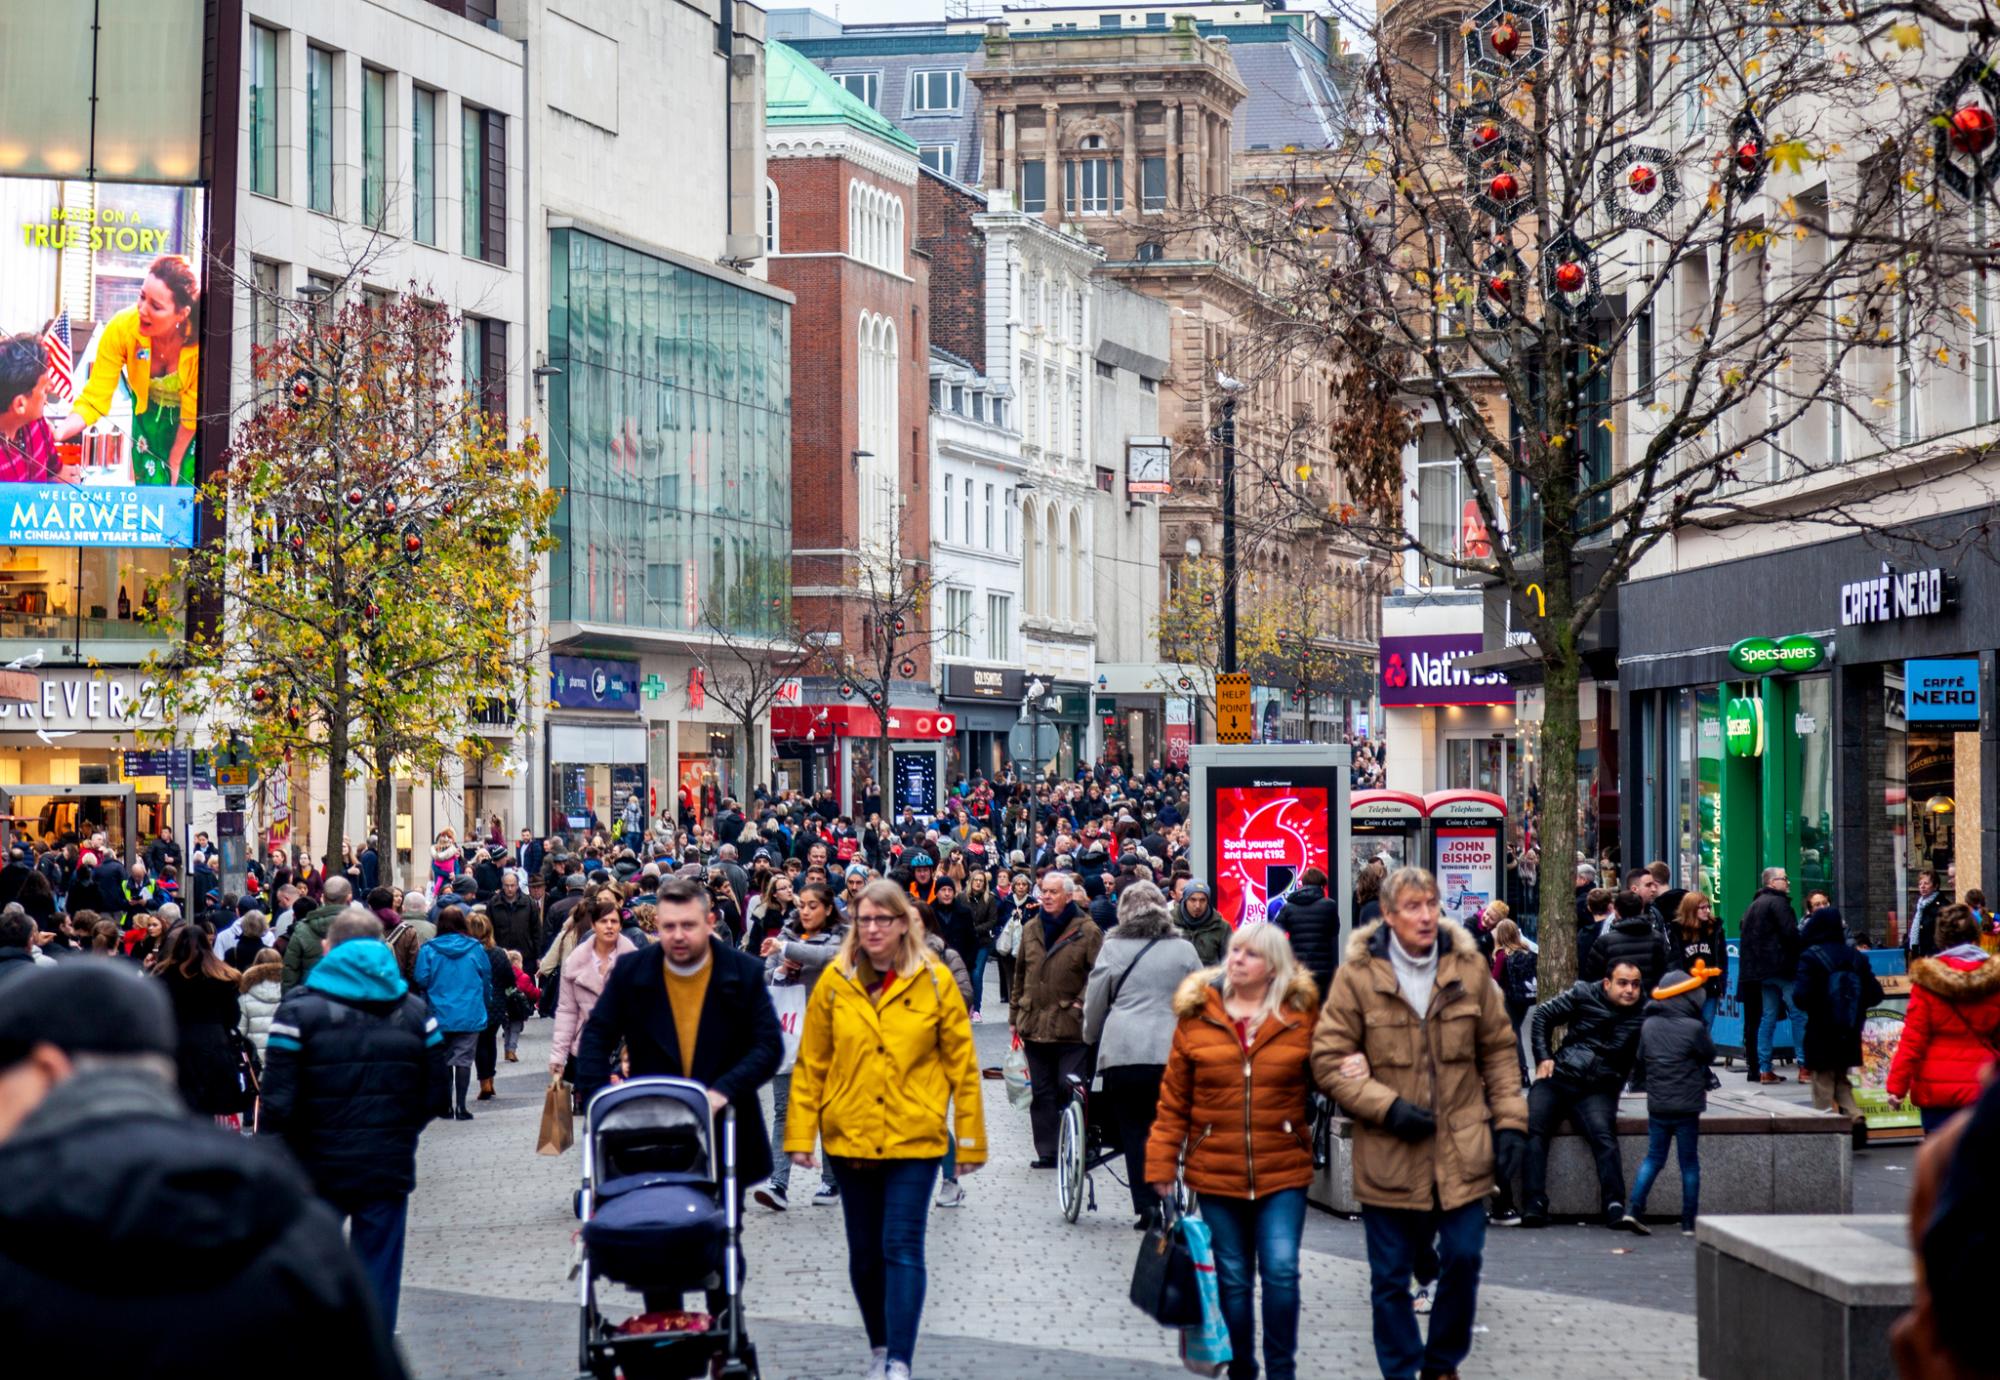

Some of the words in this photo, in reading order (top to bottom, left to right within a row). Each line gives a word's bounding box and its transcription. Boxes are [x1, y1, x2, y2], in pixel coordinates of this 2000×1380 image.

[52, 207, 96, 222] BASED
[102, 209, 125, 223] ON
[130, 211, 142, 224] A
[21, 223, 81, 249] TRUE
[89, 226, 169, 253] STORY
[39, 490, 112, 502] WELCOME
[120, 492, 137, 502] TO
[10, 501, 164, 530] MARWEN
[10, 530, 21, 540] IN
[25, 530, 71, 541] CINEMAS
[74, 531, 99, 541] NEW
[102, 531, 138, 542] YEAR'S
[141, 533, 163, 542] DAY
[1842, 561, 1890, 626] CAFFÈ
[1894, 568, 1942, 618] NERO
[1740, 646, 1817, 664] Specsavers
[1923, 676, 1965, 687] CAFFÈ
[0, 681, 124, 718] EVER
[1222, 690, 1246, 699] HELP
[1912, 690, 1976, 704] NERO
[1220, 704, 1248, 713] POINT
[1367, 805, 1403, 814] Telephone
[1449, 805, 1485, 814] Telephone
[1224, 839, 1246, 850] Spoil
[1248, 839, 1285, 850] yourself
[1448, 841, 1485, 851] JOHN
[1224, 850, 1241, 859] and
[1264, 850, 1286, 859] £192
[1442, 853, 1491, 863] BISHOP
[1246, 904, 1266, 916] BIG
